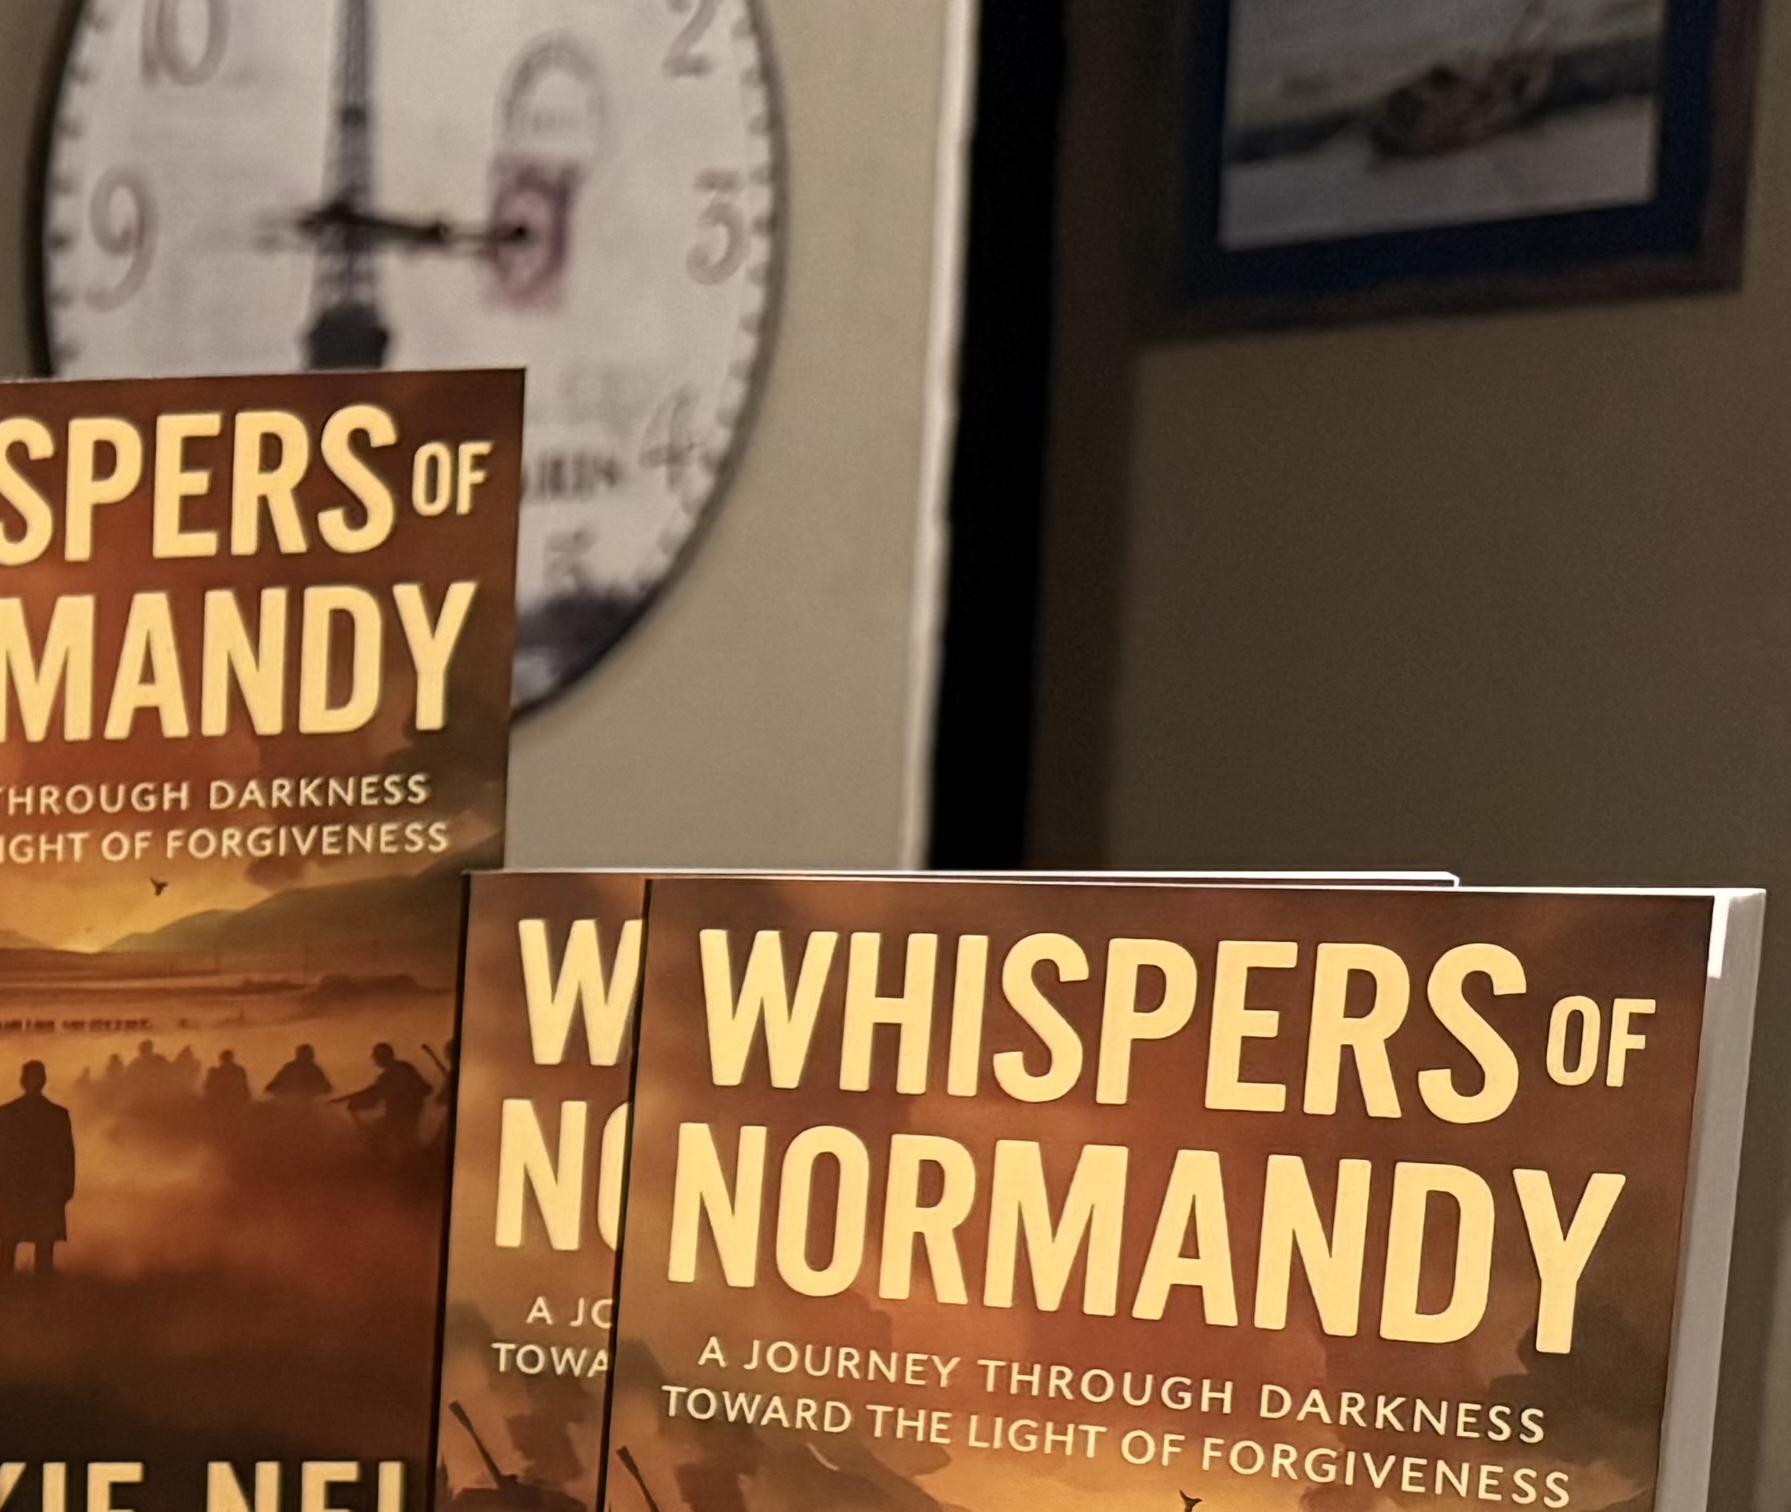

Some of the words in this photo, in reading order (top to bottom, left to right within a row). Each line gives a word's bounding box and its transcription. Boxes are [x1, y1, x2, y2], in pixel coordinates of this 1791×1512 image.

[79, 163, 159, 313] 9
[412, 441, 492, 516] OF
[101, 831, 152, 863] OF
[165, 821, 450, 860] FORGIVENESS
[209, 774, 427, 810] DARKNESS
[699, 928, 1527, 1124] WHISPERS
[1546, 995, 1656, 1088] OF
[666, 1122, 1628, 1356] NORMANDY
[526, 1296, 553, 1325] A
[697, 1336, 727, 1368] A
[743, 1339, 961, 1388] JOURNEY
[976, 1359, 1233, 1414] THROUGH
[1259, 1384, 1544, 1443] DARKNESS
[661, 1385, 853, 1433] TOWARD
[866, 1404, 953, 1445] THE
[968, 1414, 1108, 1459] LIGHT
[1121, 1429, 1186, 1467] OF
[1199, 1437, 1572, 1510] FORGIVENESS
